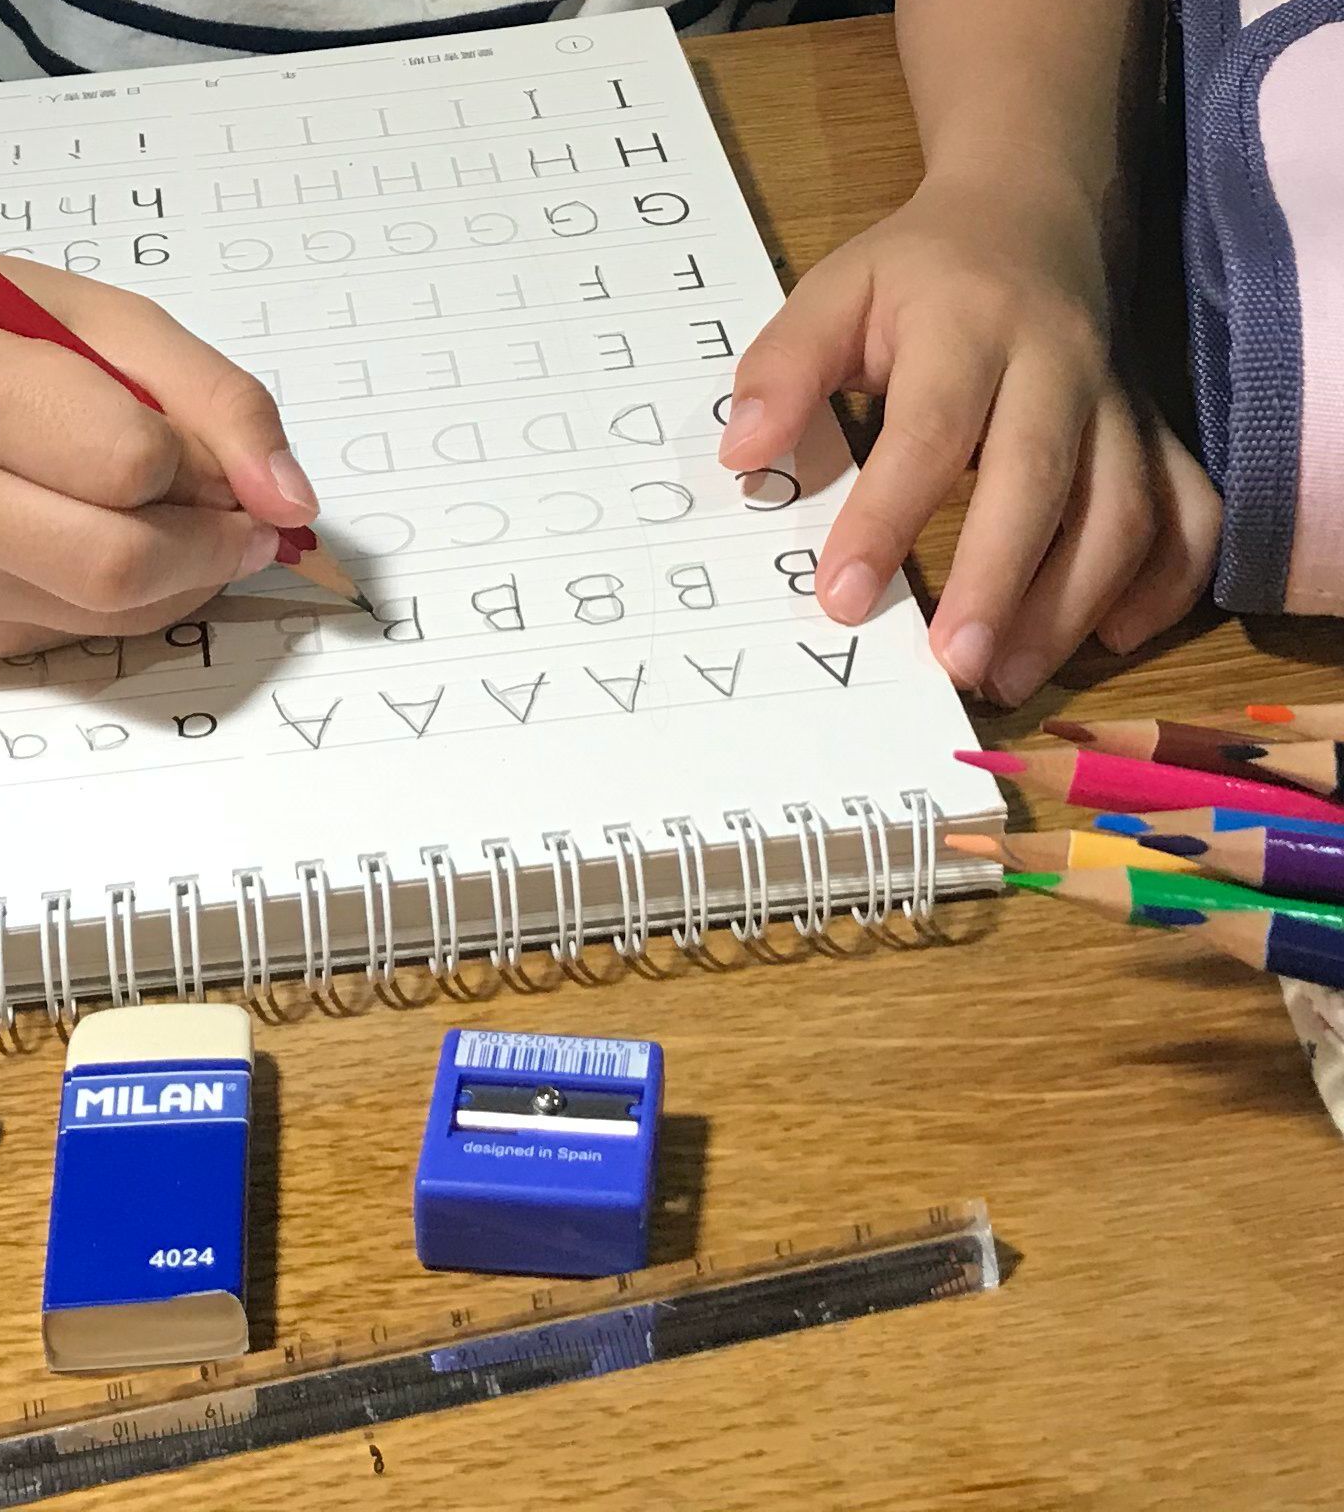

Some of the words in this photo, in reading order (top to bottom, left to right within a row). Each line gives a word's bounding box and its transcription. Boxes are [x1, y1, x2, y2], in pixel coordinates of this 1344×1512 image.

[583, 659, 648, 713] A
[684, 648, 745, 697] A
[797, 635, 859, 687] A
[271, 690, 342, 749] A
[378, 685, 445, 738] A
[481, 671, 551, 723] A
[478, 1031, 547, 1047] 025306
[76, 1082, 225, 1118] MILAN
[463, 1140, 535, 1159] designed
[539, 1145, 553, 1159] in
[557, 1148, 602, 1164] Spain
[148, 1247, 215, 1269] 4024
